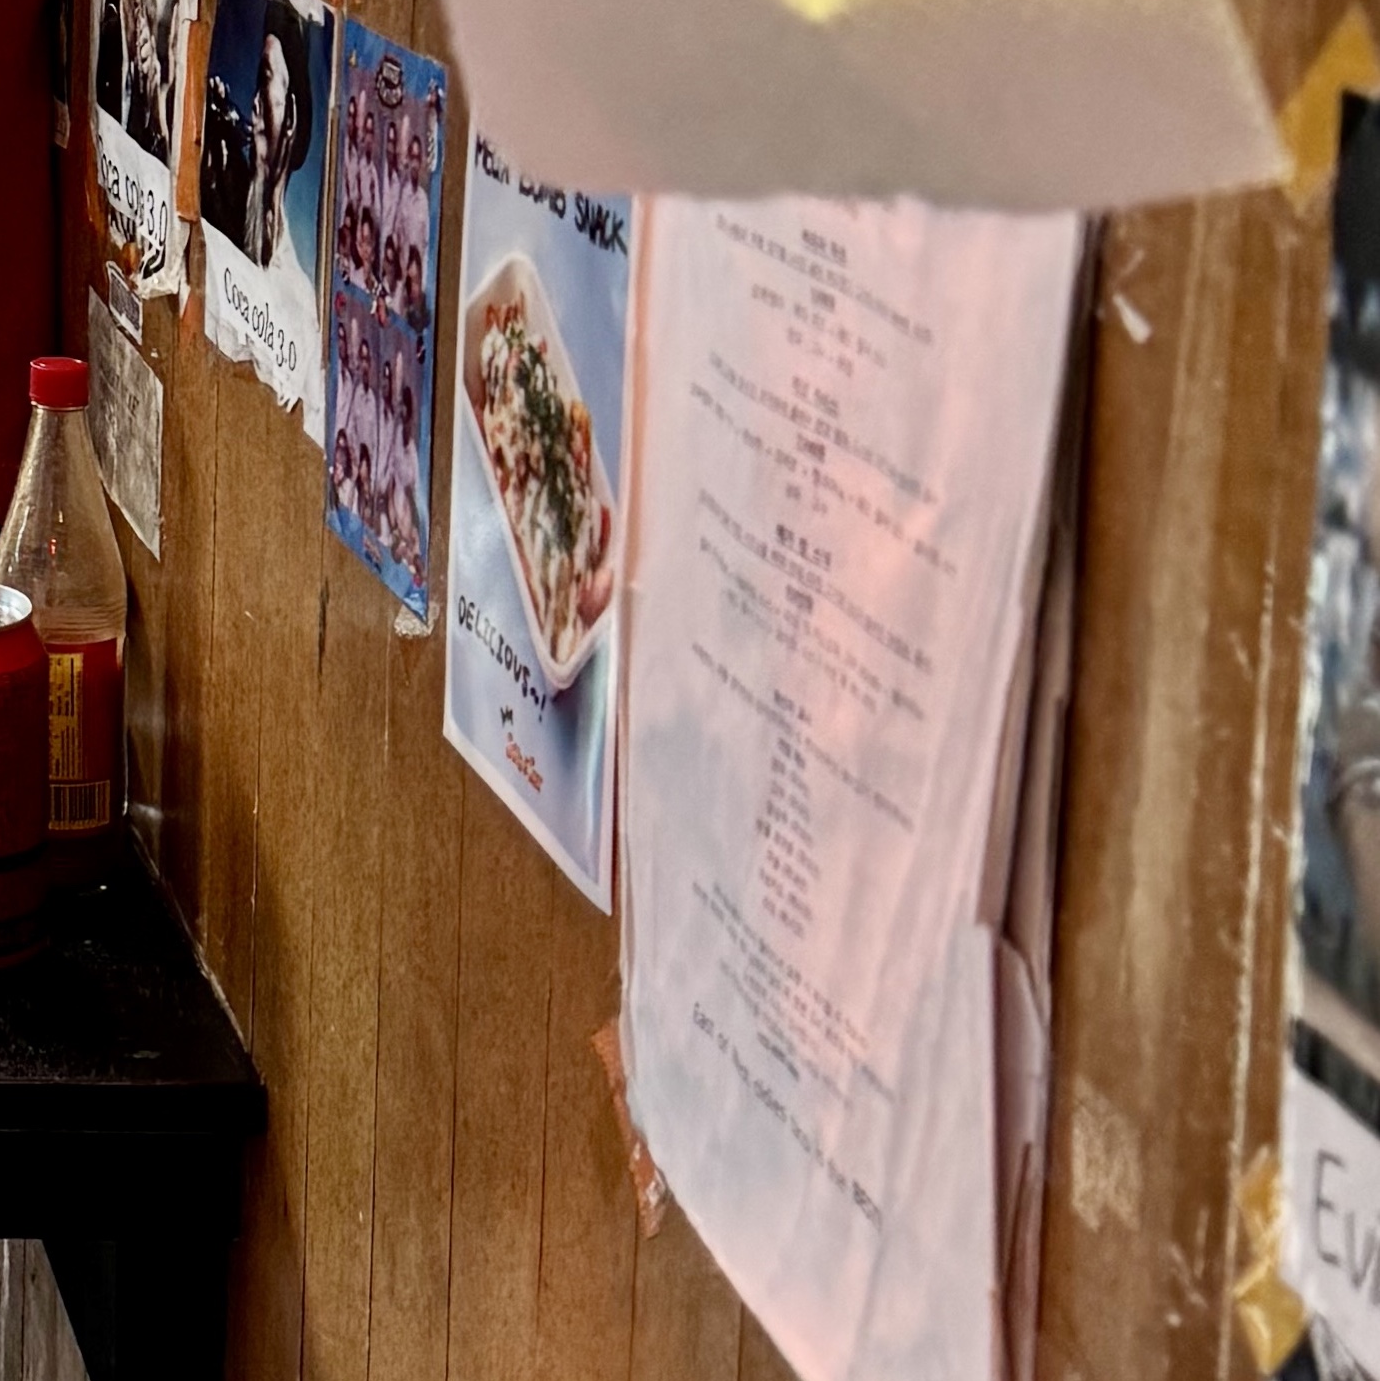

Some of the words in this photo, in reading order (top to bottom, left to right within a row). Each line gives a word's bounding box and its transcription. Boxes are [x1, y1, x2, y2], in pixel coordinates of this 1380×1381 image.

[224, 268, 249, 324] Coca
[251, 303, 274, 349] cola
[275, 329, 297, 372] 3.0
